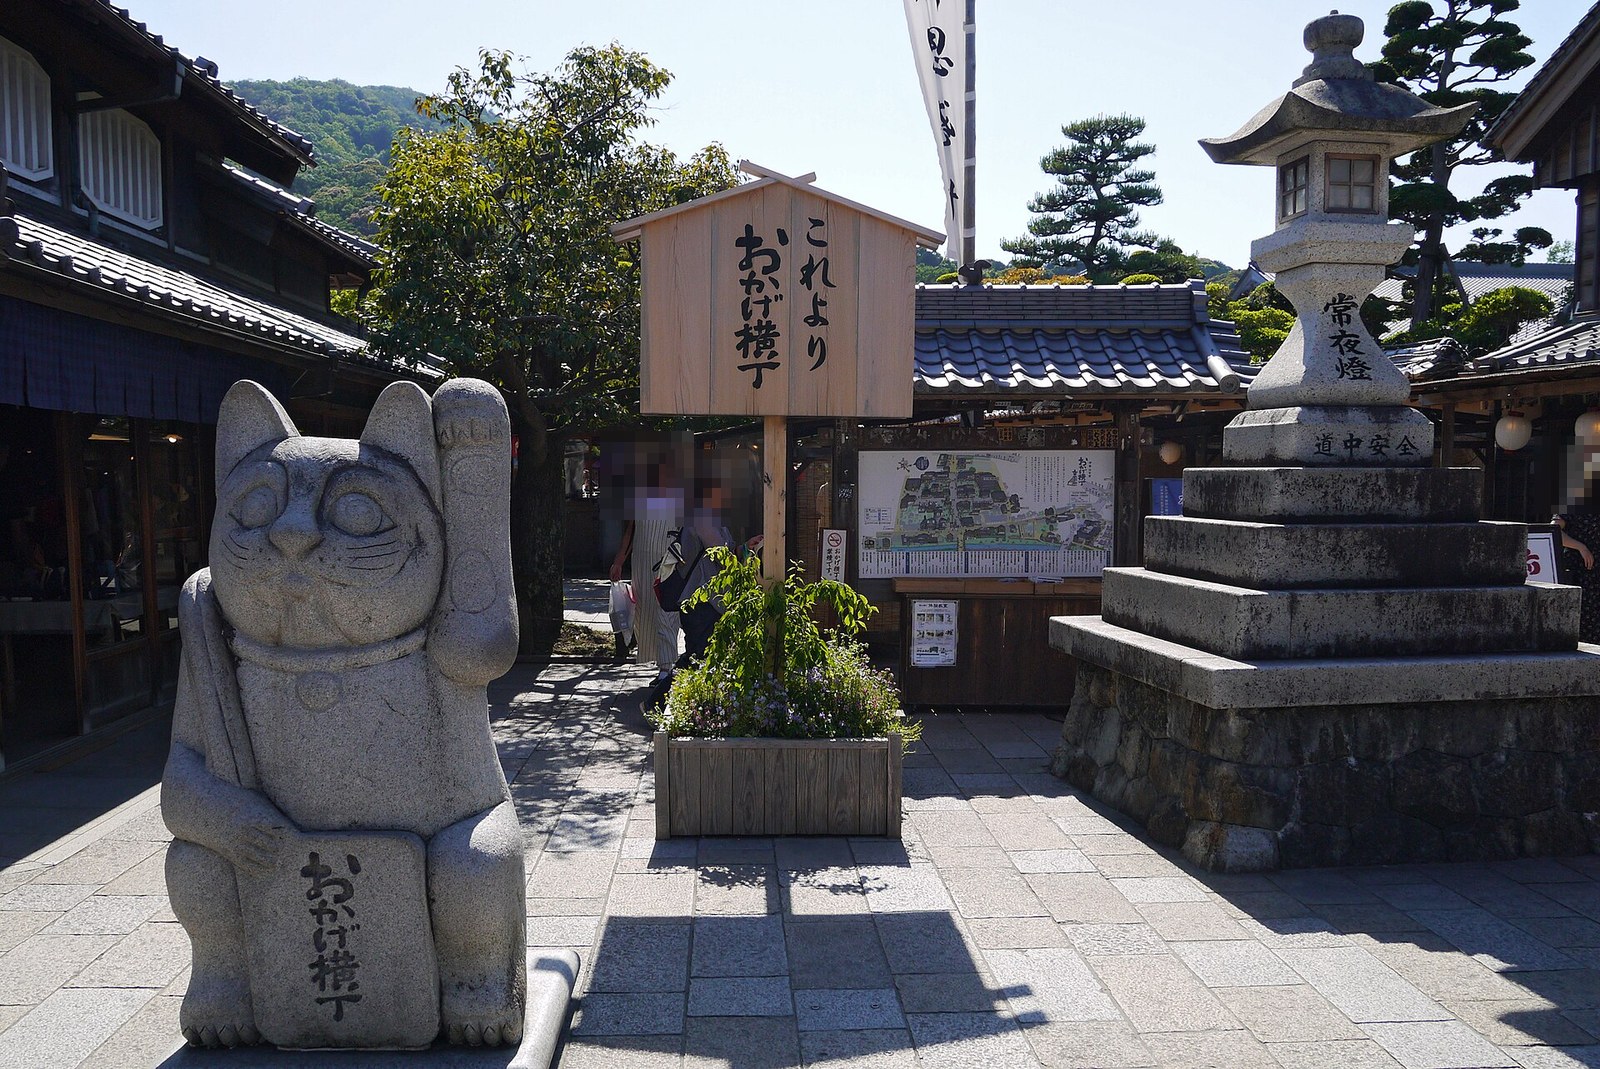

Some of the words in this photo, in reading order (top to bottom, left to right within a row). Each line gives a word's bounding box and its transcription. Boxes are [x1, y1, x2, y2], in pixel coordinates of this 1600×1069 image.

[735, 224, 789, 389] おかげ横丁
[800, 217, 837, 371] これより
[1323, 292, 1373, 381] 常夜燈
[1313, 433, 1420, 457] 道中安全
[300, 851, 363, 1022] おかげ横丁
